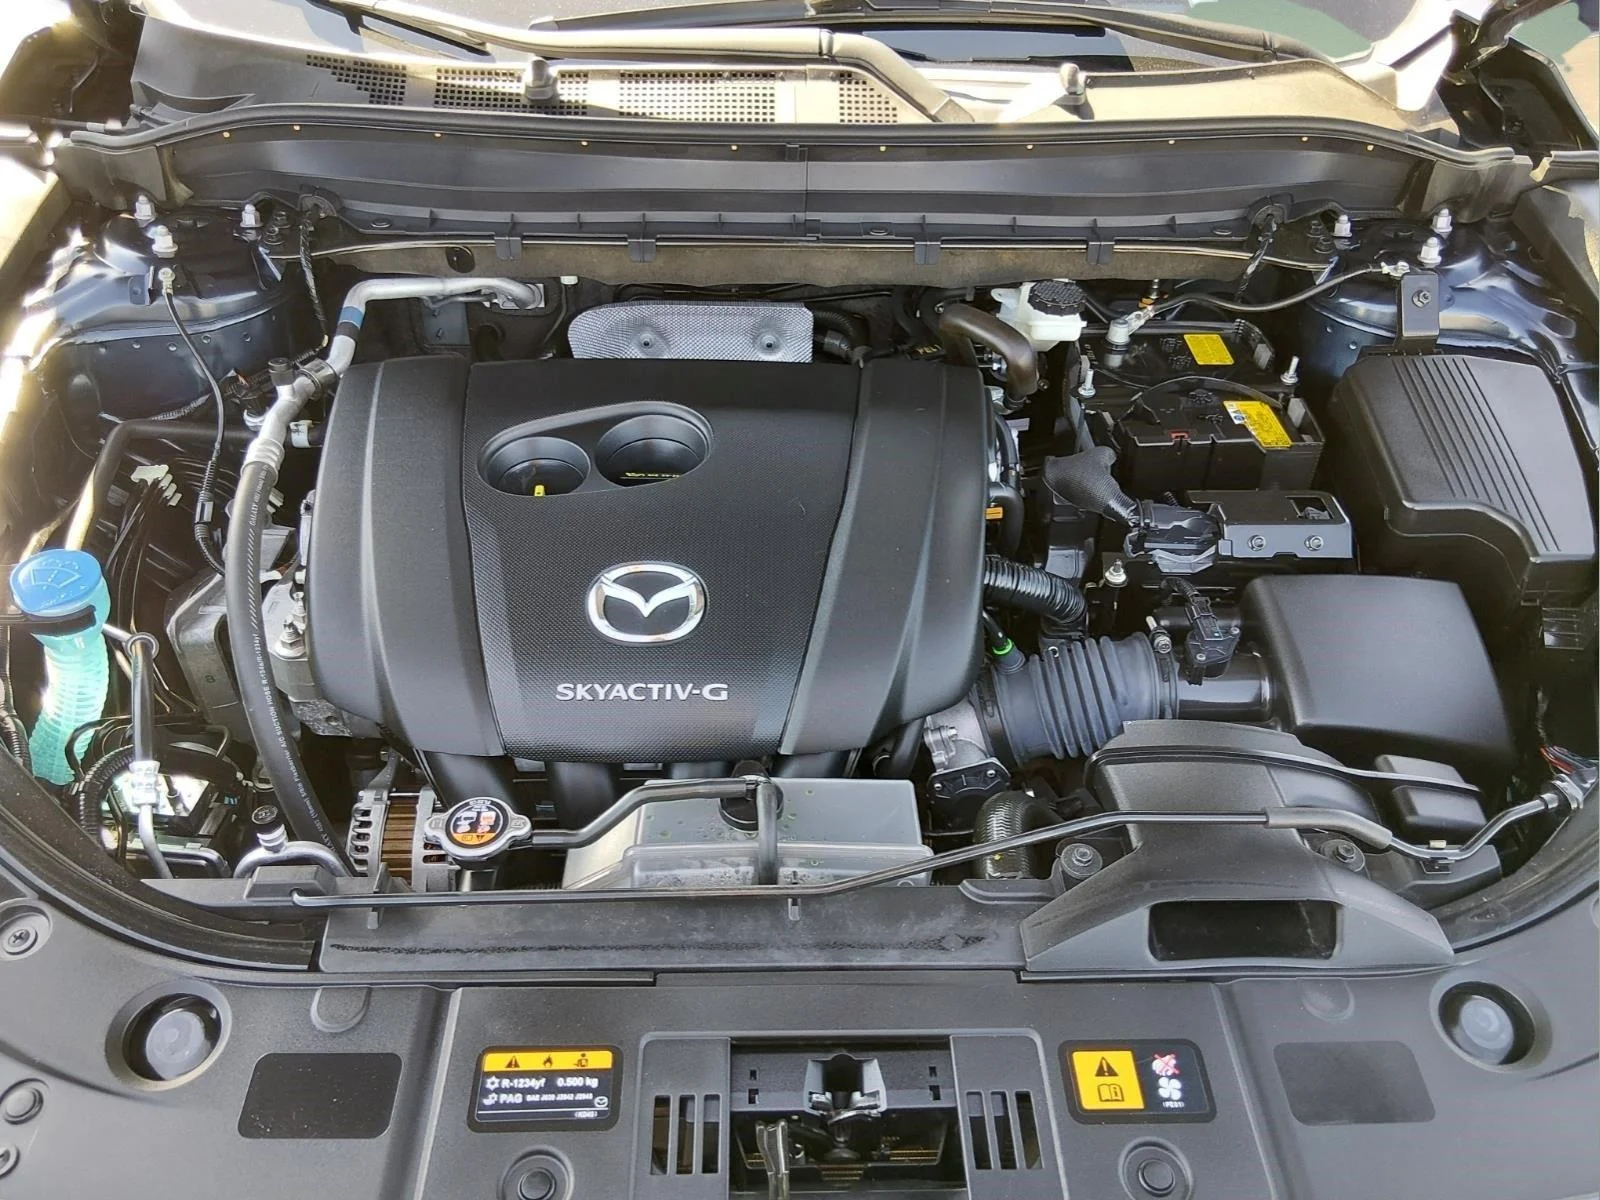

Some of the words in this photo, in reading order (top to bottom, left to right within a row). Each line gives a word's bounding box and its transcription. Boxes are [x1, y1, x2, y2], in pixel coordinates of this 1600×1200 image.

[262, 686, 274, 704] HOSE
[555, 683, 729, 701] SKYACTIV-G
[268, 706, 283, 735] SUCTION
[501, 1077, 546, 1089] R-1234yf
[556, 1077, 583, 1088] 0.500
[585, 1076, 599, 1089] kg
[499, 1093, 523, 1104] PAG
